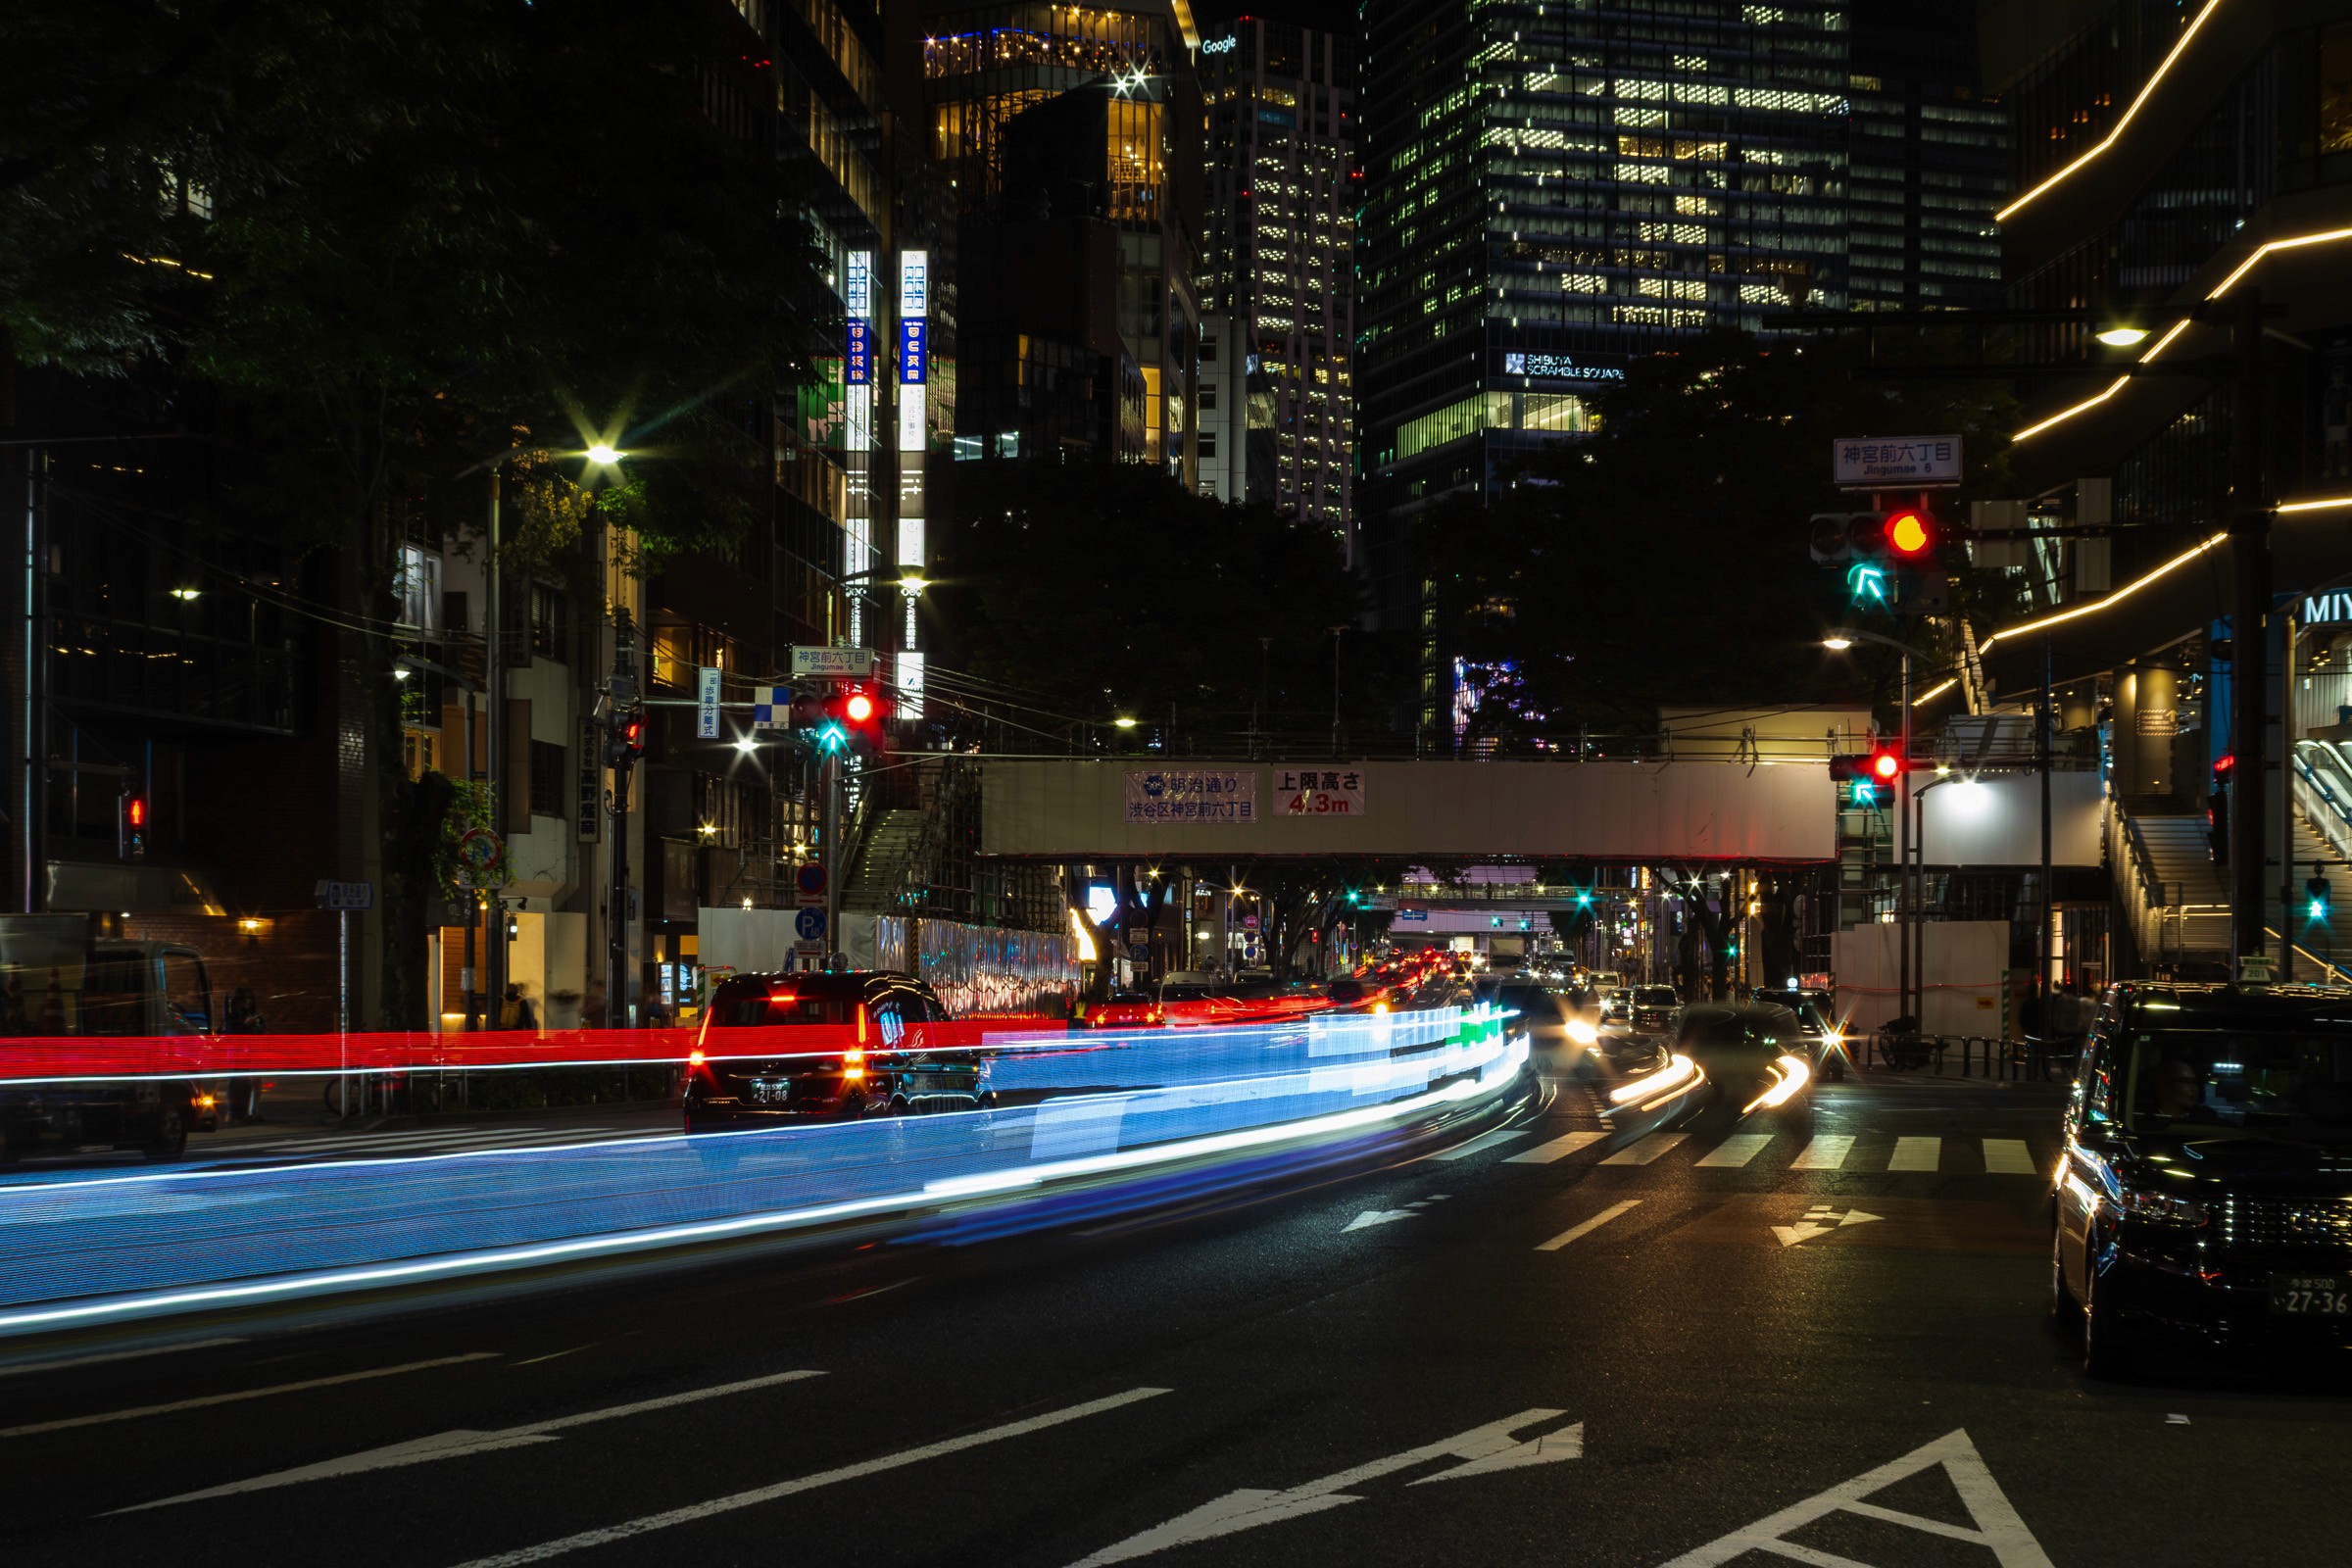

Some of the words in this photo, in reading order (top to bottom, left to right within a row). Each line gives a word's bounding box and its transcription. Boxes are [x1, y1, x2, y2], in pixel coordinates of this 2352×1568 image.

[1202, 34, 1236, 54] Google
[907, 326, 920, 380] DUKE
[1527, 354, 1572, 367] SHIBUYA
[1527, 365, 1581, 377] SCRAMBLE
[1583, 368, 1625, 380] SQUARE
[1843, 443, 1951, 465] 神宮前六丁目
[1864, 465, 1917, 476] Jingumae
[1924, 464, 1932, 473] 6
[799, 651, 865, 664] 神宮前六丁目
[1171, 777, 1237, 794] 明治通り
[1278, 772, 1360, 791] 上限高さ
[1129, 802, 1251, 817] 渋谷区神宮前六丁目
[1289, 793, 1349, 813] 4.3m
[802, 915, 814, 936] P
[809, 927, 819, 937] 60
[2314, 1279, 2335, 1290] 500
[2286, 1291, 2348, 1314] 27-36
